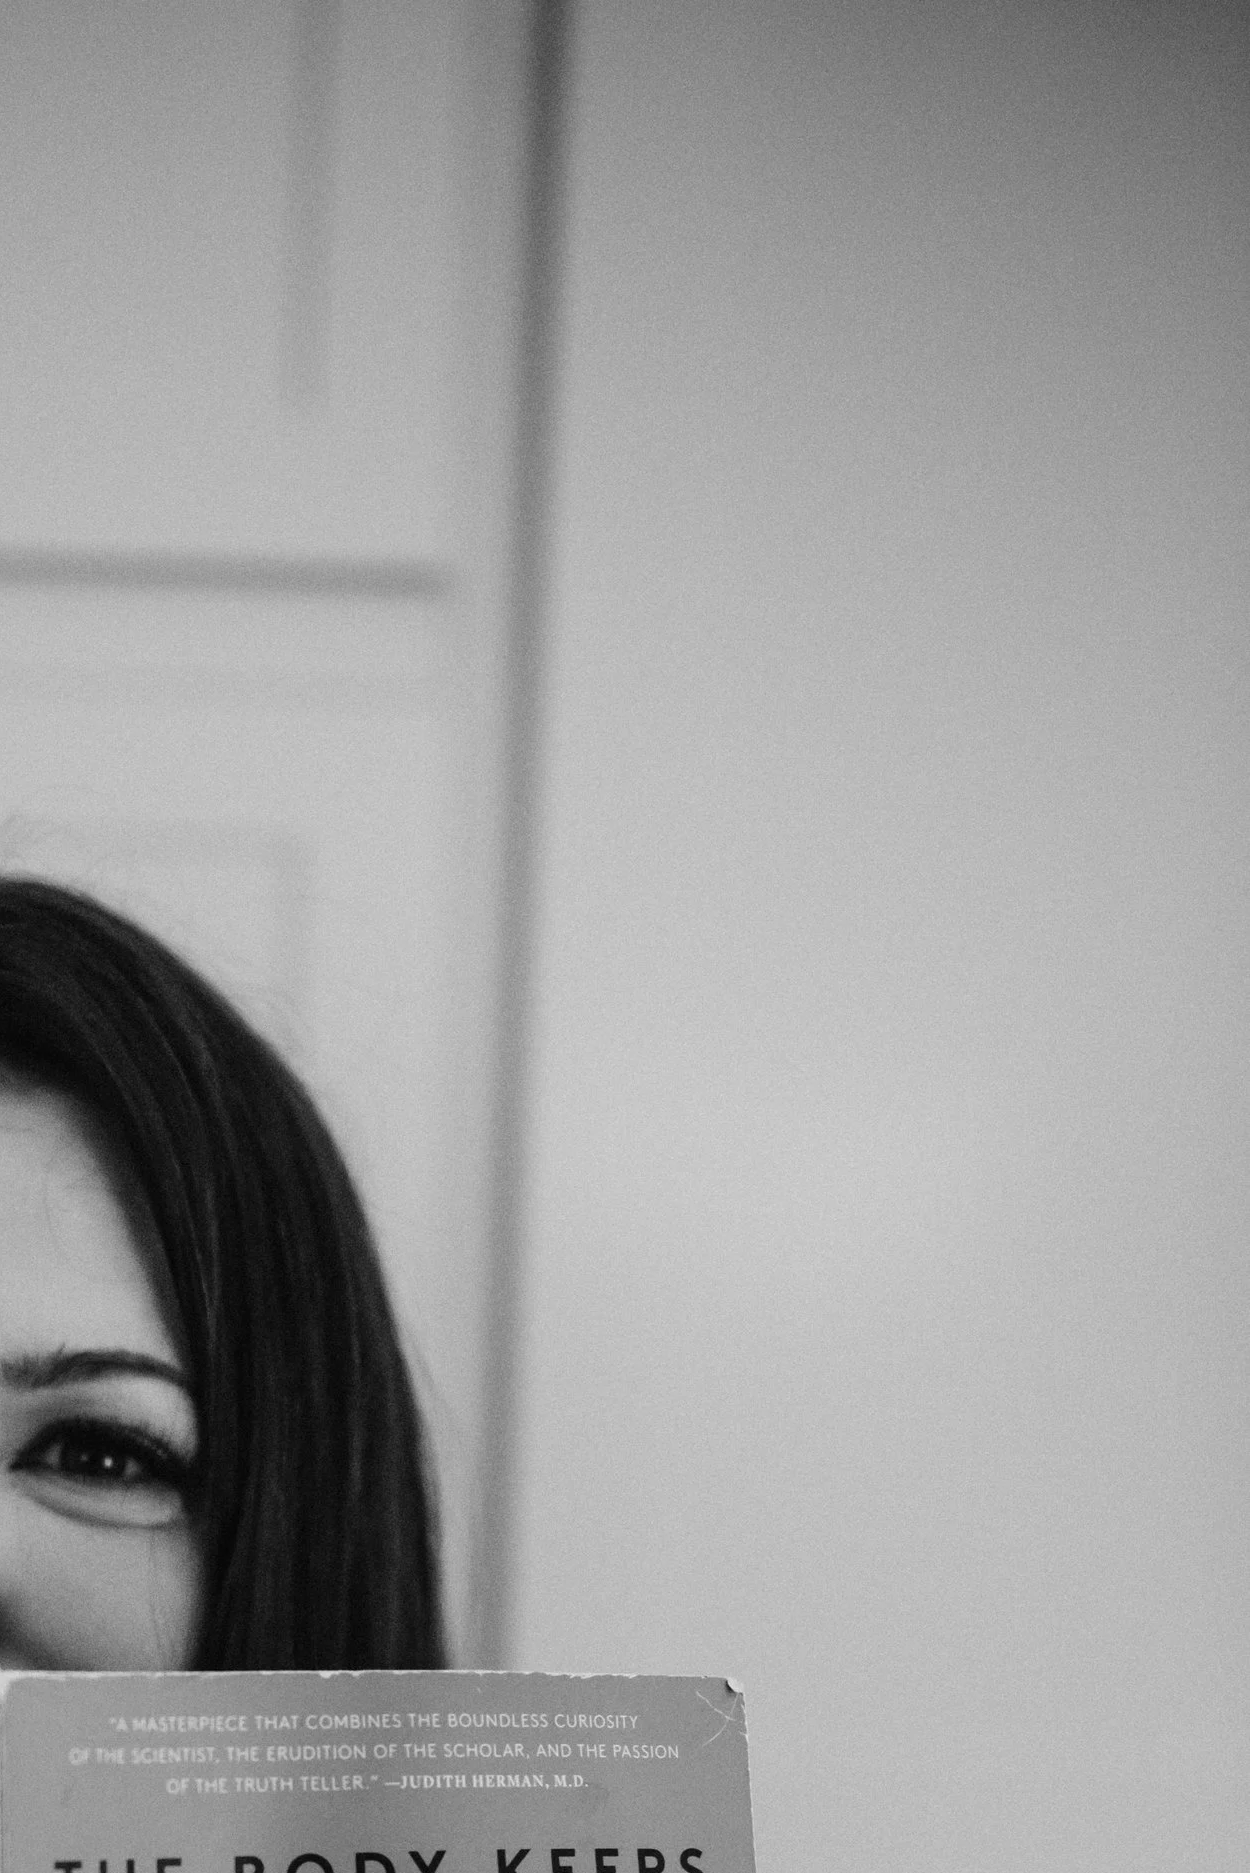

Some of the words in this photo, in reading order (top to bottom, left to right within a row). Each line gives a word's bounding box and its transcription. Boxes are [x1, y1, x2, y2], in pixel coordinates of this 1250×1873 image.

[110, 1718, 127, 1731] “A
[132, 1716, 247, 1732] MASTERPIECE
[255, 1715, 298, 1729] THAT
[305, 1714, 401, 1730] COMBINES
[408, 1713, 440, 1728] THE
[448, 1713, 548, 1728] BOUNDLESS
[555, 1714, 637, 1729] CURIOSITY
[69, 1748, 90, 1765] OF
[96, 1748, 124, 1764] THE
[131, 1747, 219, 1764] SCIENTIST,
[226, 1747, 258, 1761] THE
[266, 1745, 366, 1762] ERUDITION
[374, 1744, 397, 1759] OF
[404, 1743, 436, 1758] THE
[444, 1743, 530, 1759] SCHOLAR,
[536, 1744, 572, 1757] AND
[577, 1744, 606, 1758] THE
[613, 1744, 679, 1759] PASSION
[166, 1778, 189, 1794] OF
[195, 1778, 227, 1793] THE
[235, 1777, 293, 1792] TRUTH
[300, 1775, 378, 1791] TELLER.”
[386, 1775, 466, 1788] —JUDITH
[473, 1775, 549, 1791] HERMAN,
[554, 1775, 590, 1787] M.D.
